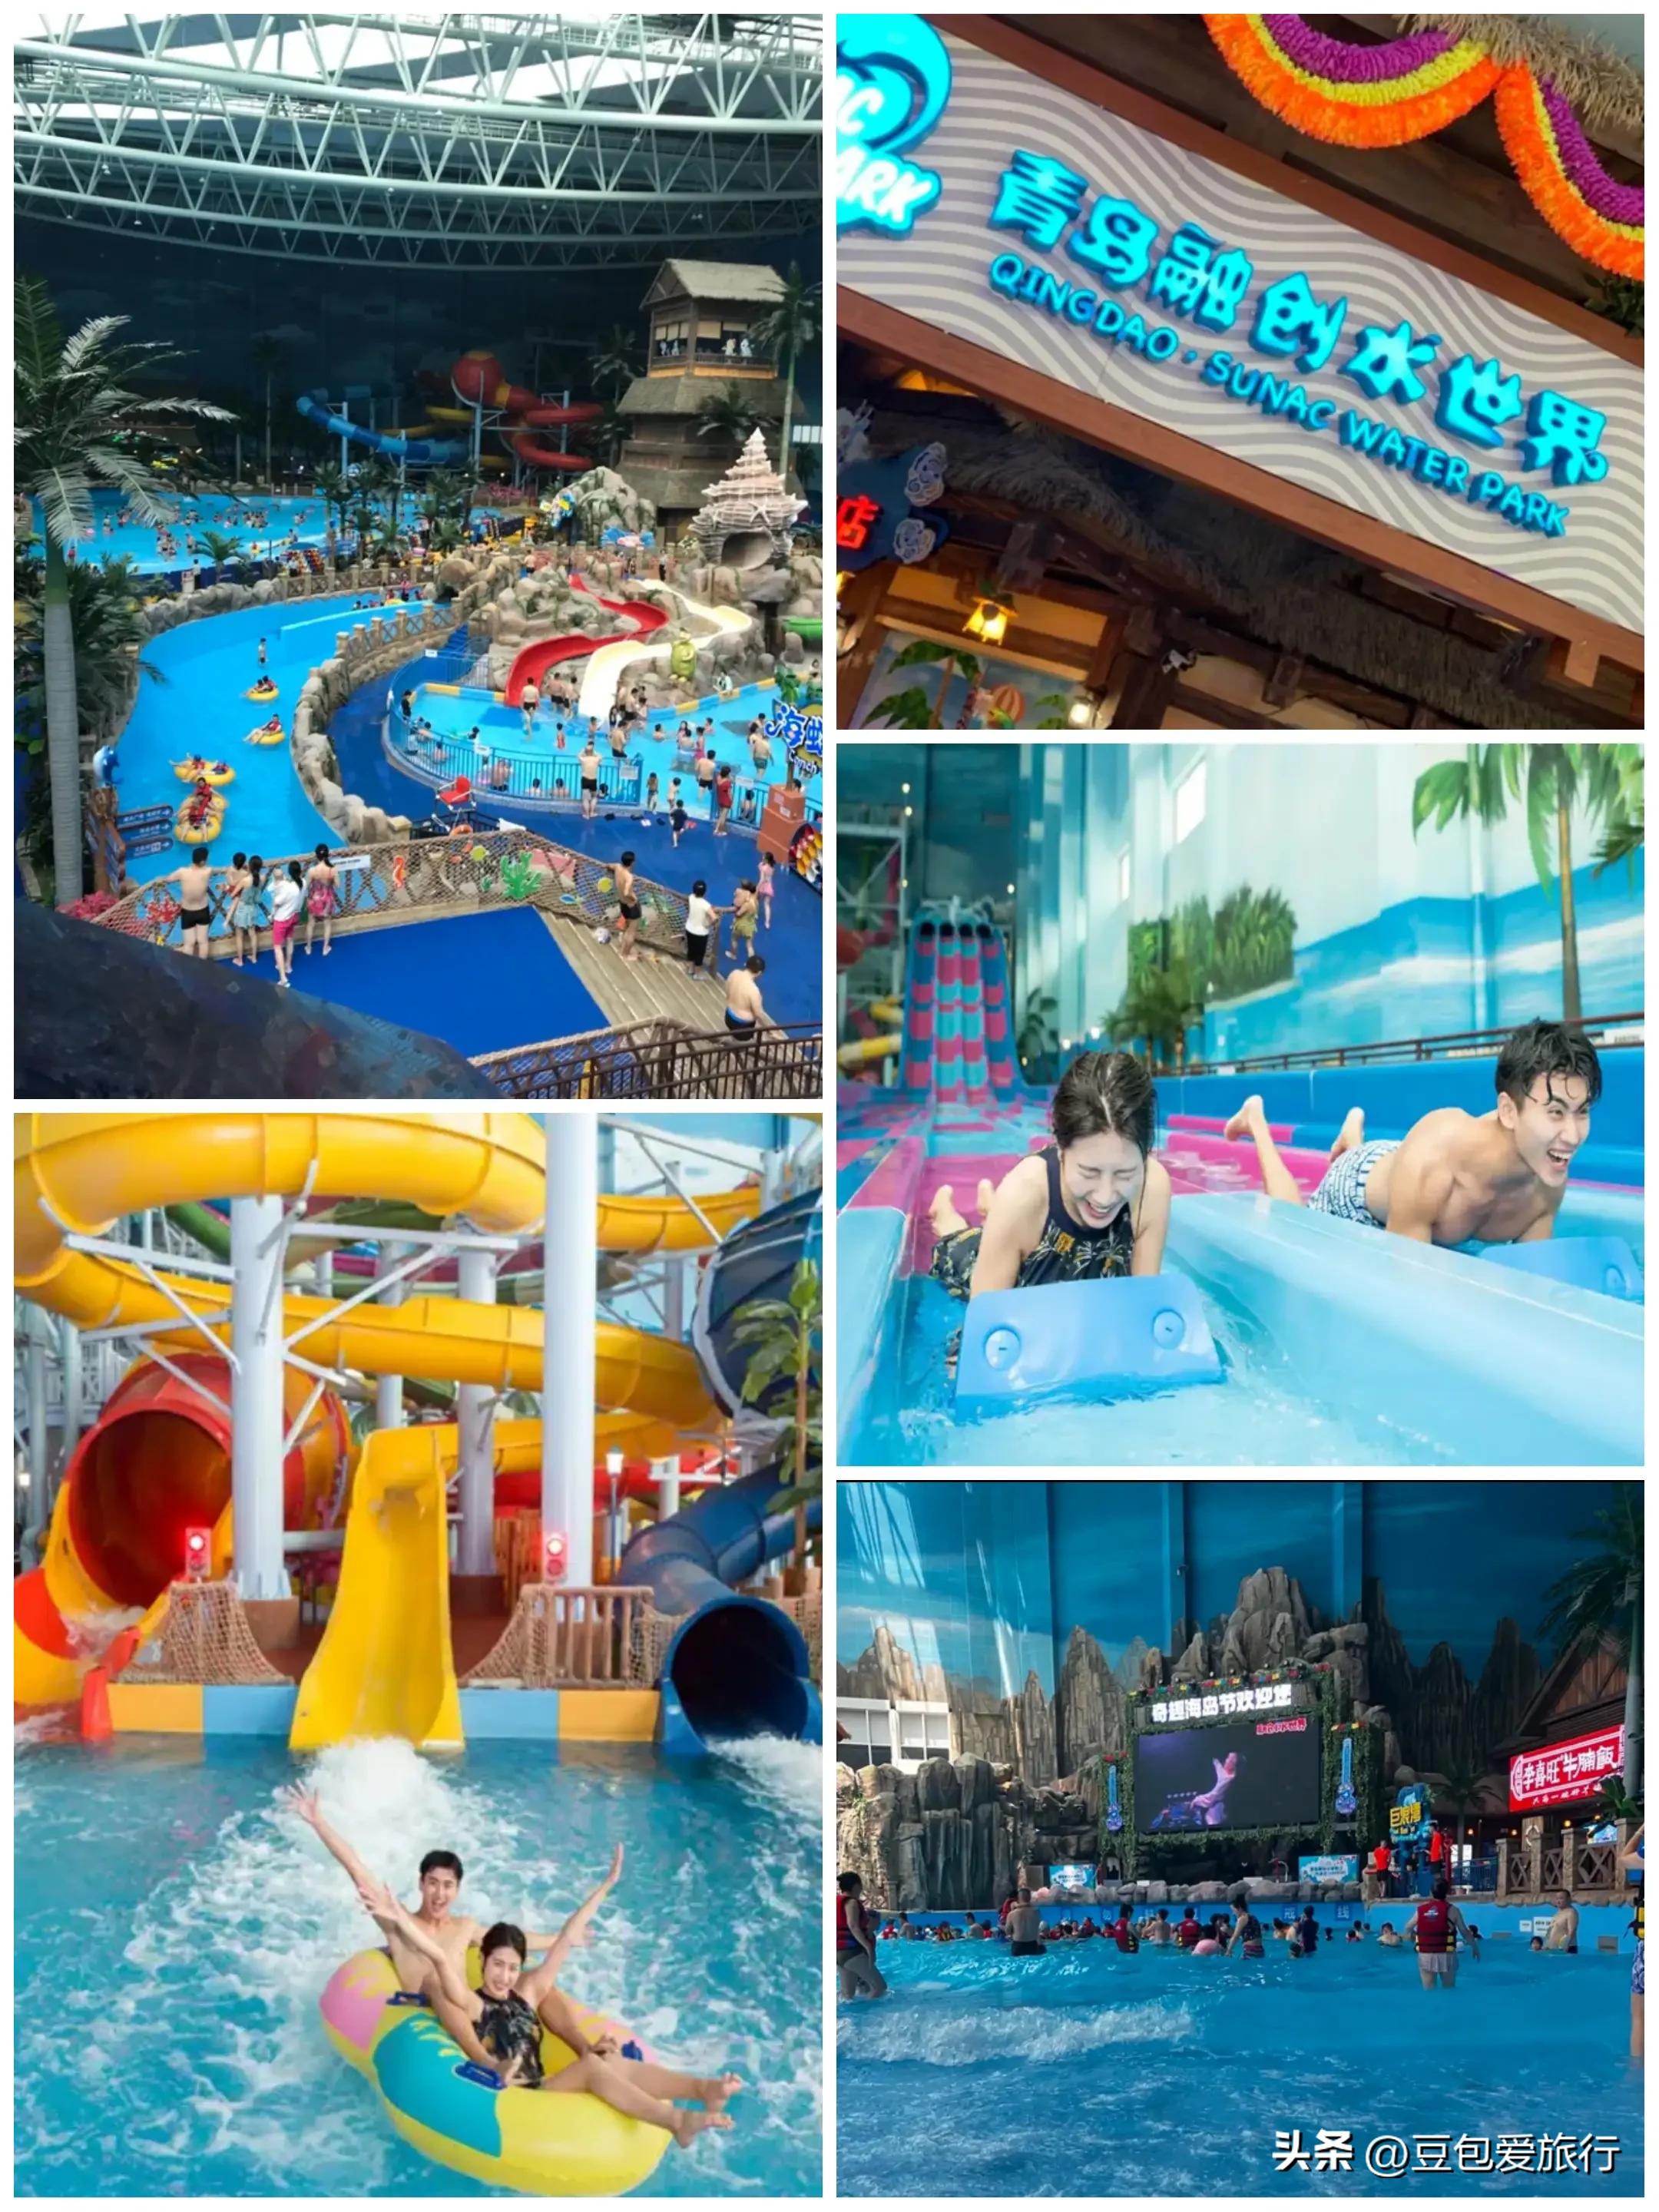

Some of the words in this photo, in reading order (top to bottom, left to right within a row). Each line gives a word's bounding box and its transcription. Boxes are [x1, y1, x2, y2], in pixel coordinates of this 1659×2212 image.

[988, 149, 1609, 486] 青岛融创水世界
[989, 253, 1179, 366] QINGDAO
[1200, 351, 1336, 431] SUNAC
[1339, 409, 1470, 494] WATER
[1468, 472, 1569, 538] PARK
